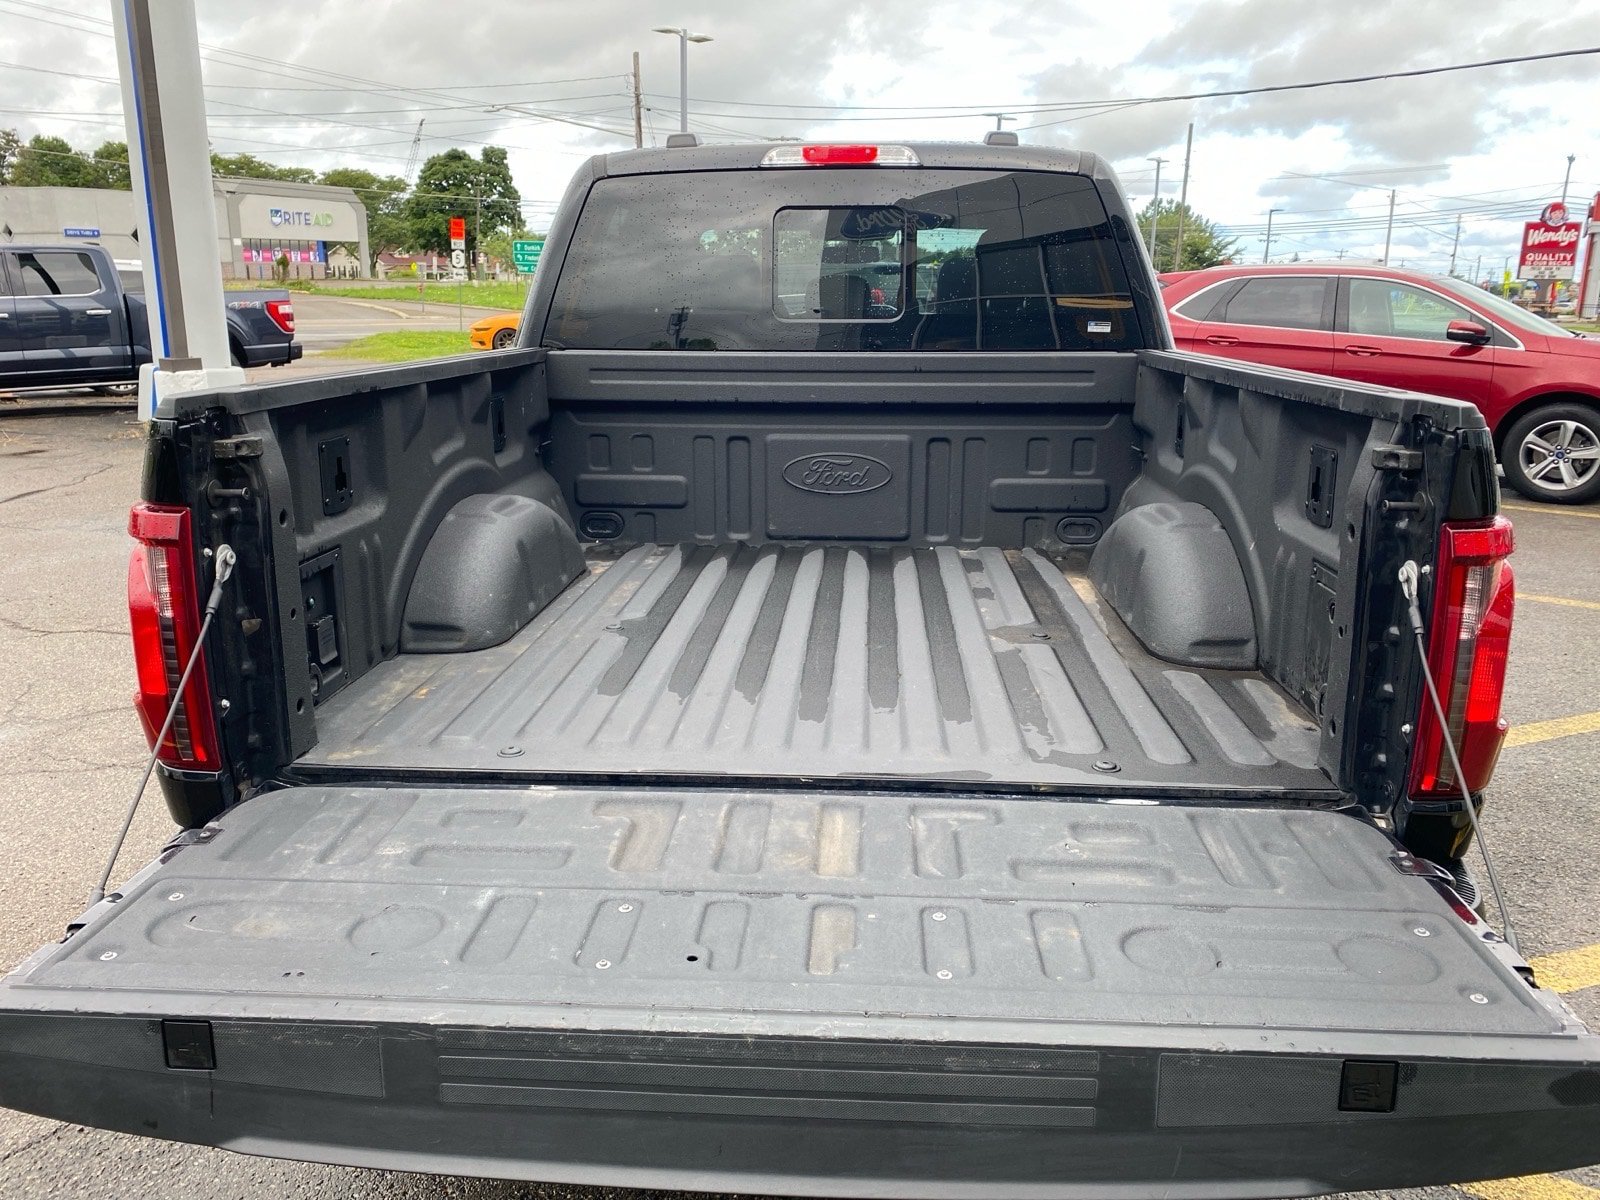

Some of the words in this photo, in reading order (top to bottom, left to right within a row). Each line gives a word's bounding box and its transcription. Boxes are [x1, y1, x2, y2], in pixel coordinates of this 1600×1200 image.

[283, 211, 311, 225] RITE
[313, 212, 334, 226] AID
[1527, 226, 1578, 246] Wendy's
[456, 254, 462, 264] 5
[1525, 253, 1573, 261] QUALITY
[802, 459, 870, 486] Ford
